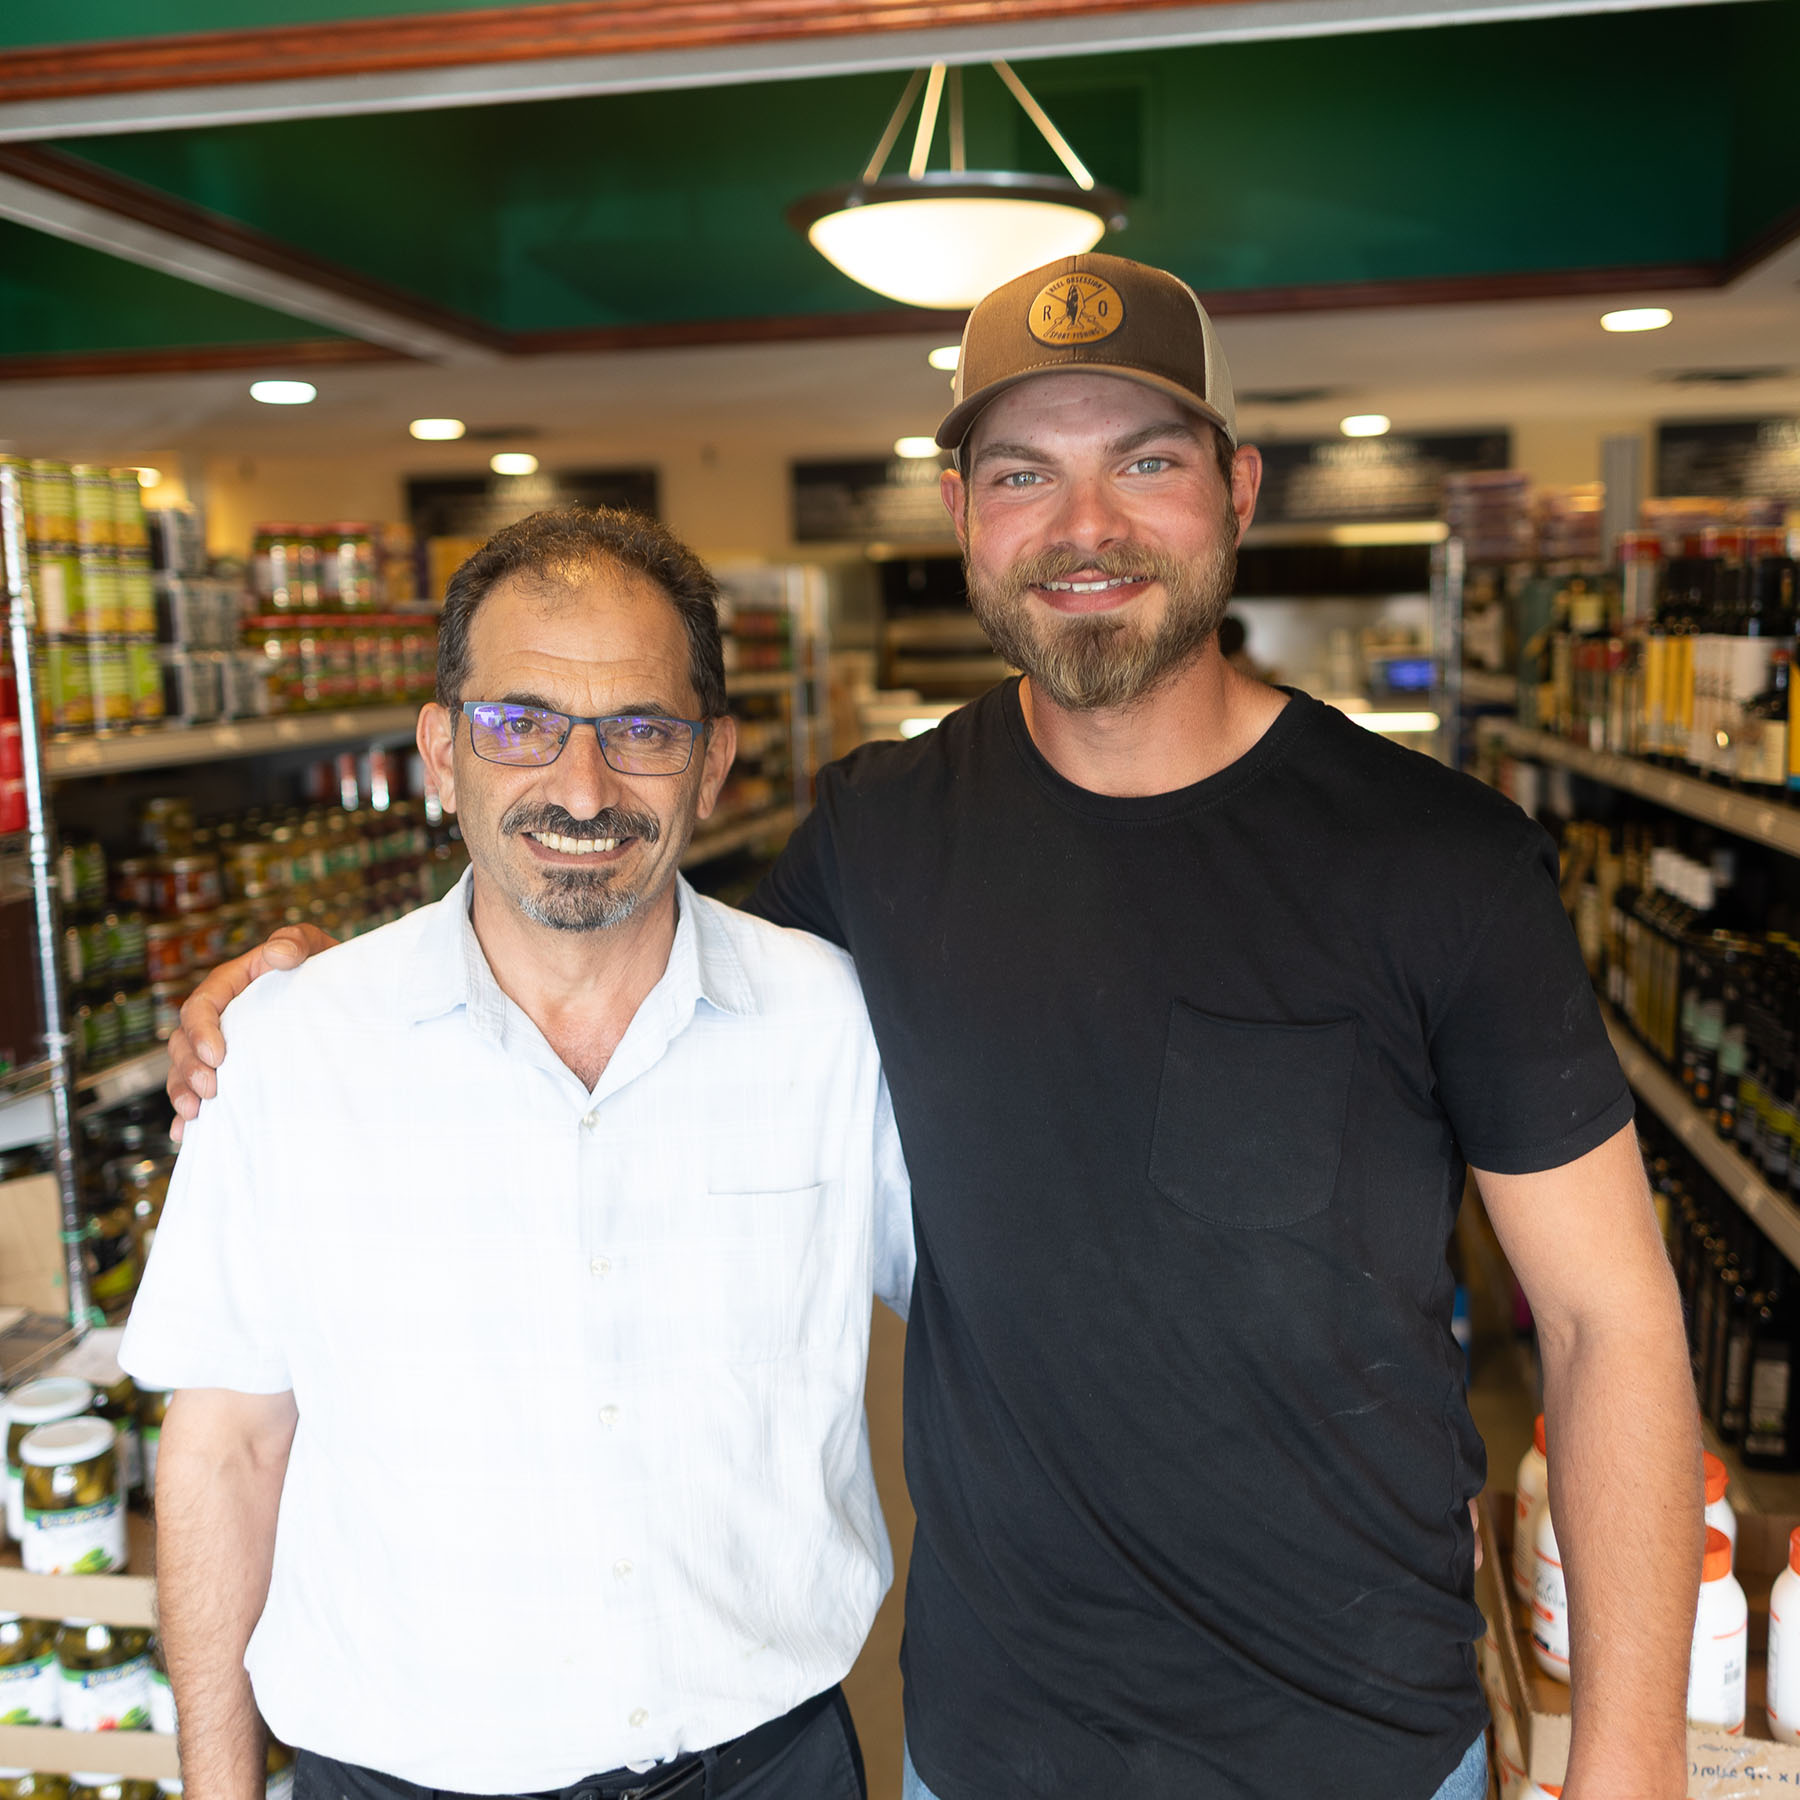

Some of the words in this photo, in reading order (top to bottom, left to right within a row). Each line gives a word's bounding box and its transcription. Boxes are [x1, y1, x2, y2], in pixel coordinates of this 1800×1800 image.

[1049, 281, 1065, 292] REEL
[1066, 276, 1103, 289] OBSESSION
[1043, 304, 1052, 321] R
[1098, 300, 1108, 317] O
